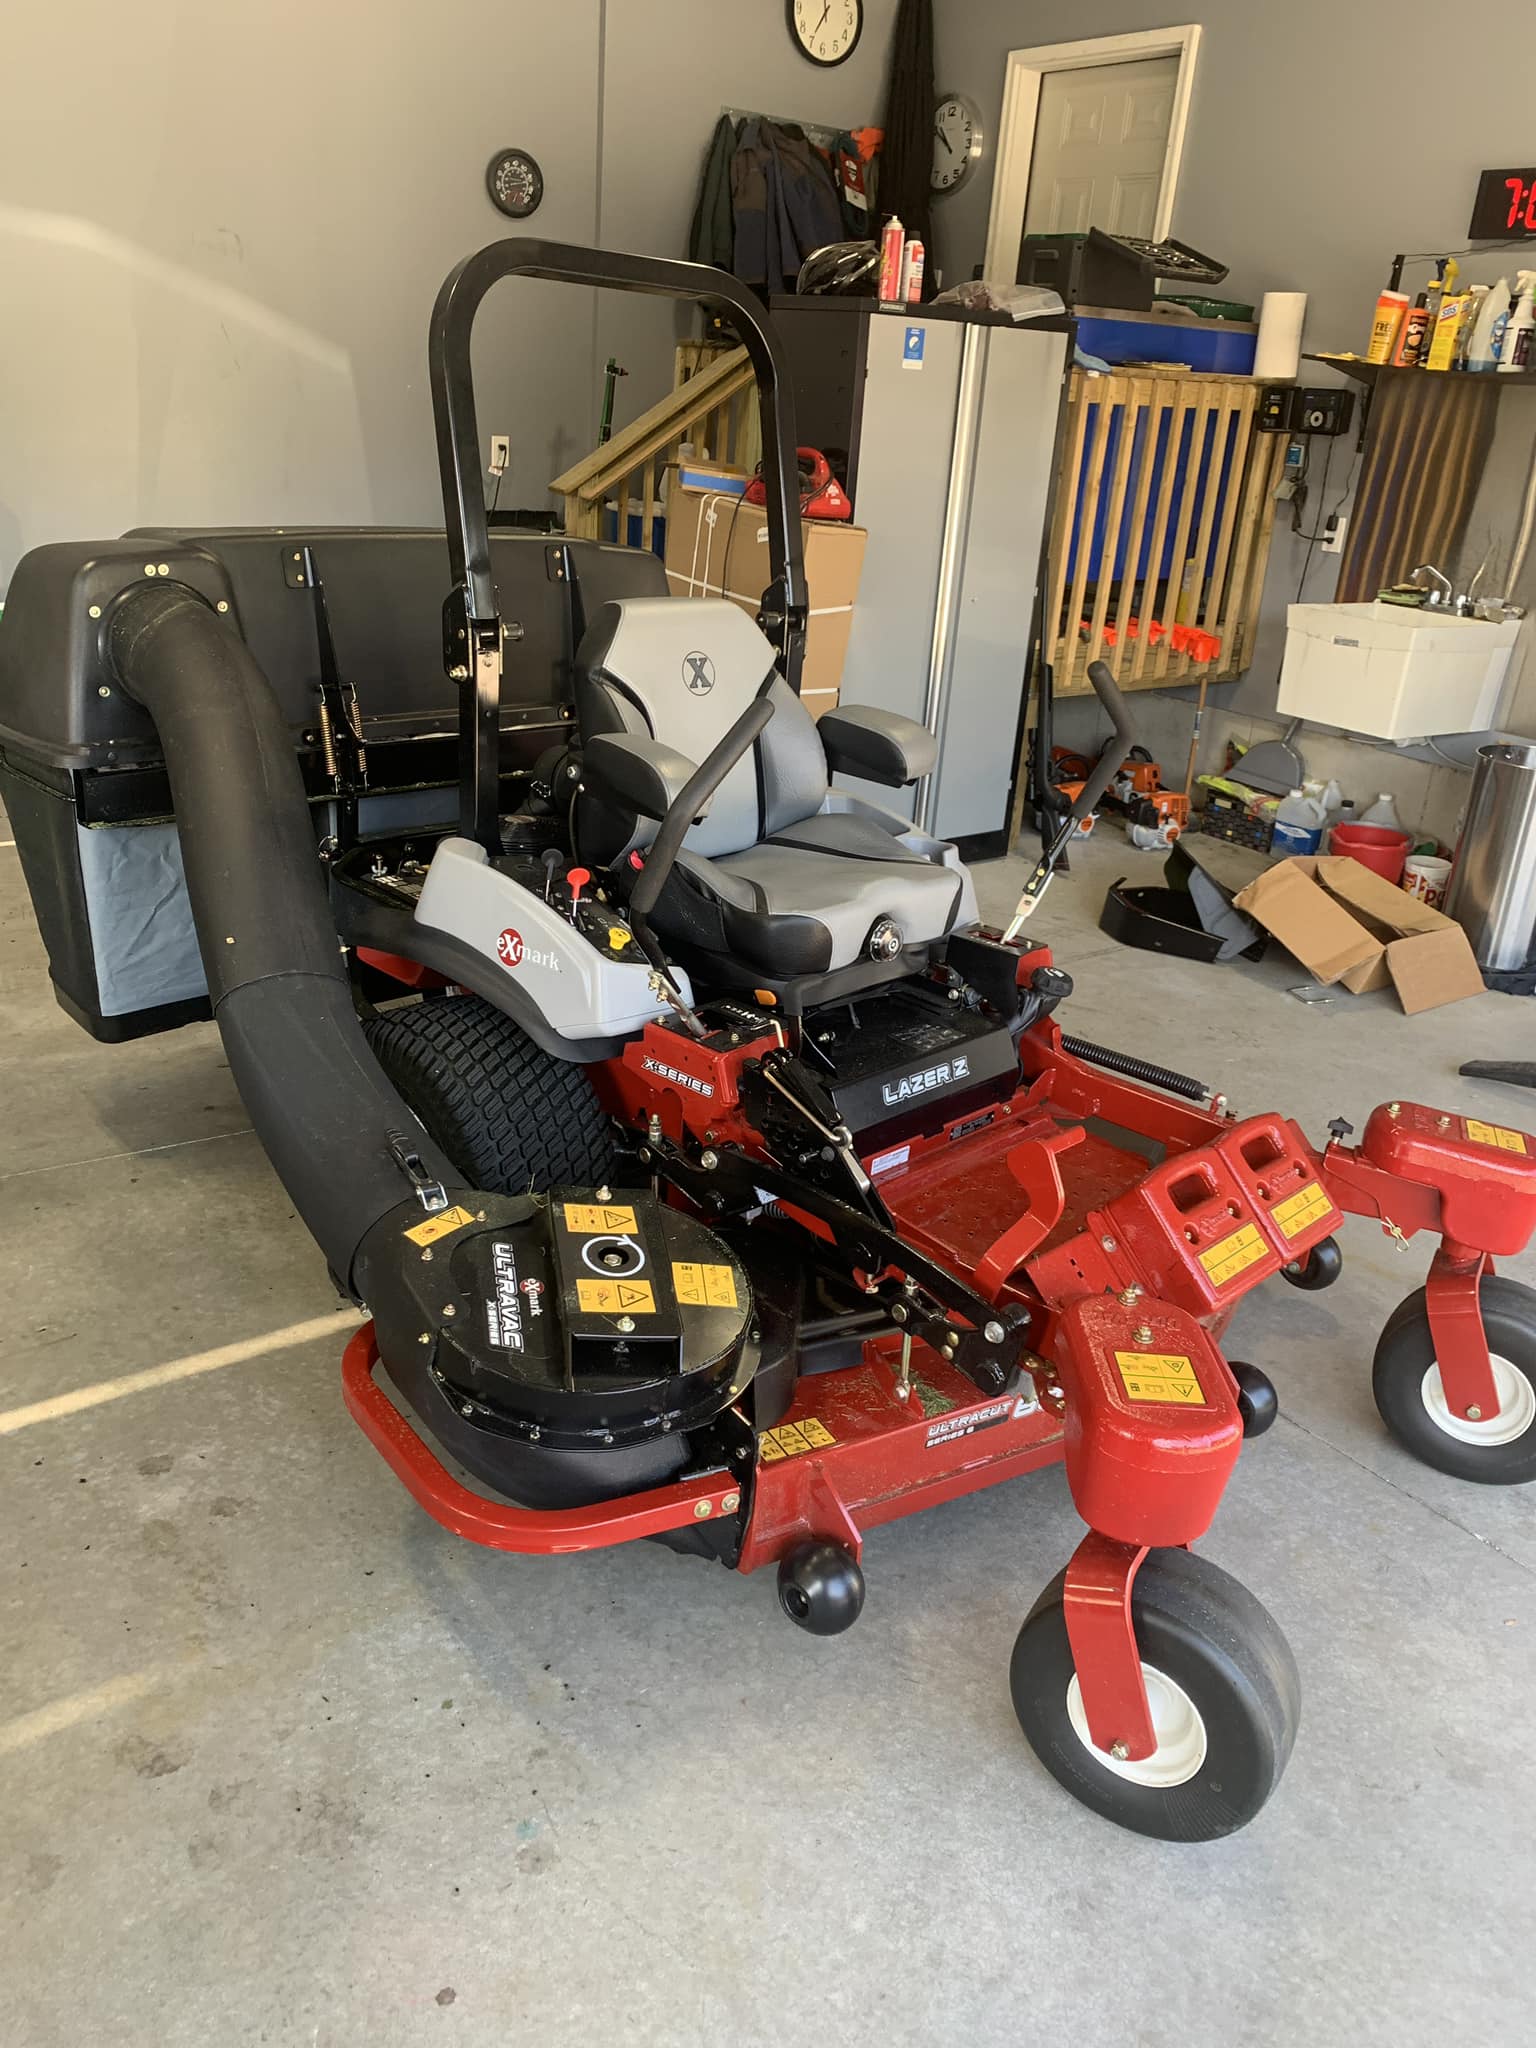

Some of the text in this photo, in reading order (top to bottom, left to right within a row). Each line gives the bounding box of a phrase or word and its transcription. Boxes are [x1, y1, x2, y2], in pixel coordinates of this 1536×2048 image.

[847, 11, 853, 26] 3
[800, 20, 806, 33] 8
[809, 35, 815, 48] 7
[842, 28, 848, 42] 4
[820, 42, 826, 56] 6
[833, 40, 839, 53] 5
[947, 106, 957, 117] 12
[964, 121, 972, 132] 2
[965, 138, 972, 149] 3
[942, 175, 949, 185] 6
[953, 168, 960, 179] 5
[687, 657, 712, 689] X
[643, 1056, 714, 1098] X-SERIES
[884, 1056, 969, 1105] LAZER Z
[493, 1242, 524, 1350] ULTRAVAC
[927, 1400, 1013, 1438] ULTRACUT
